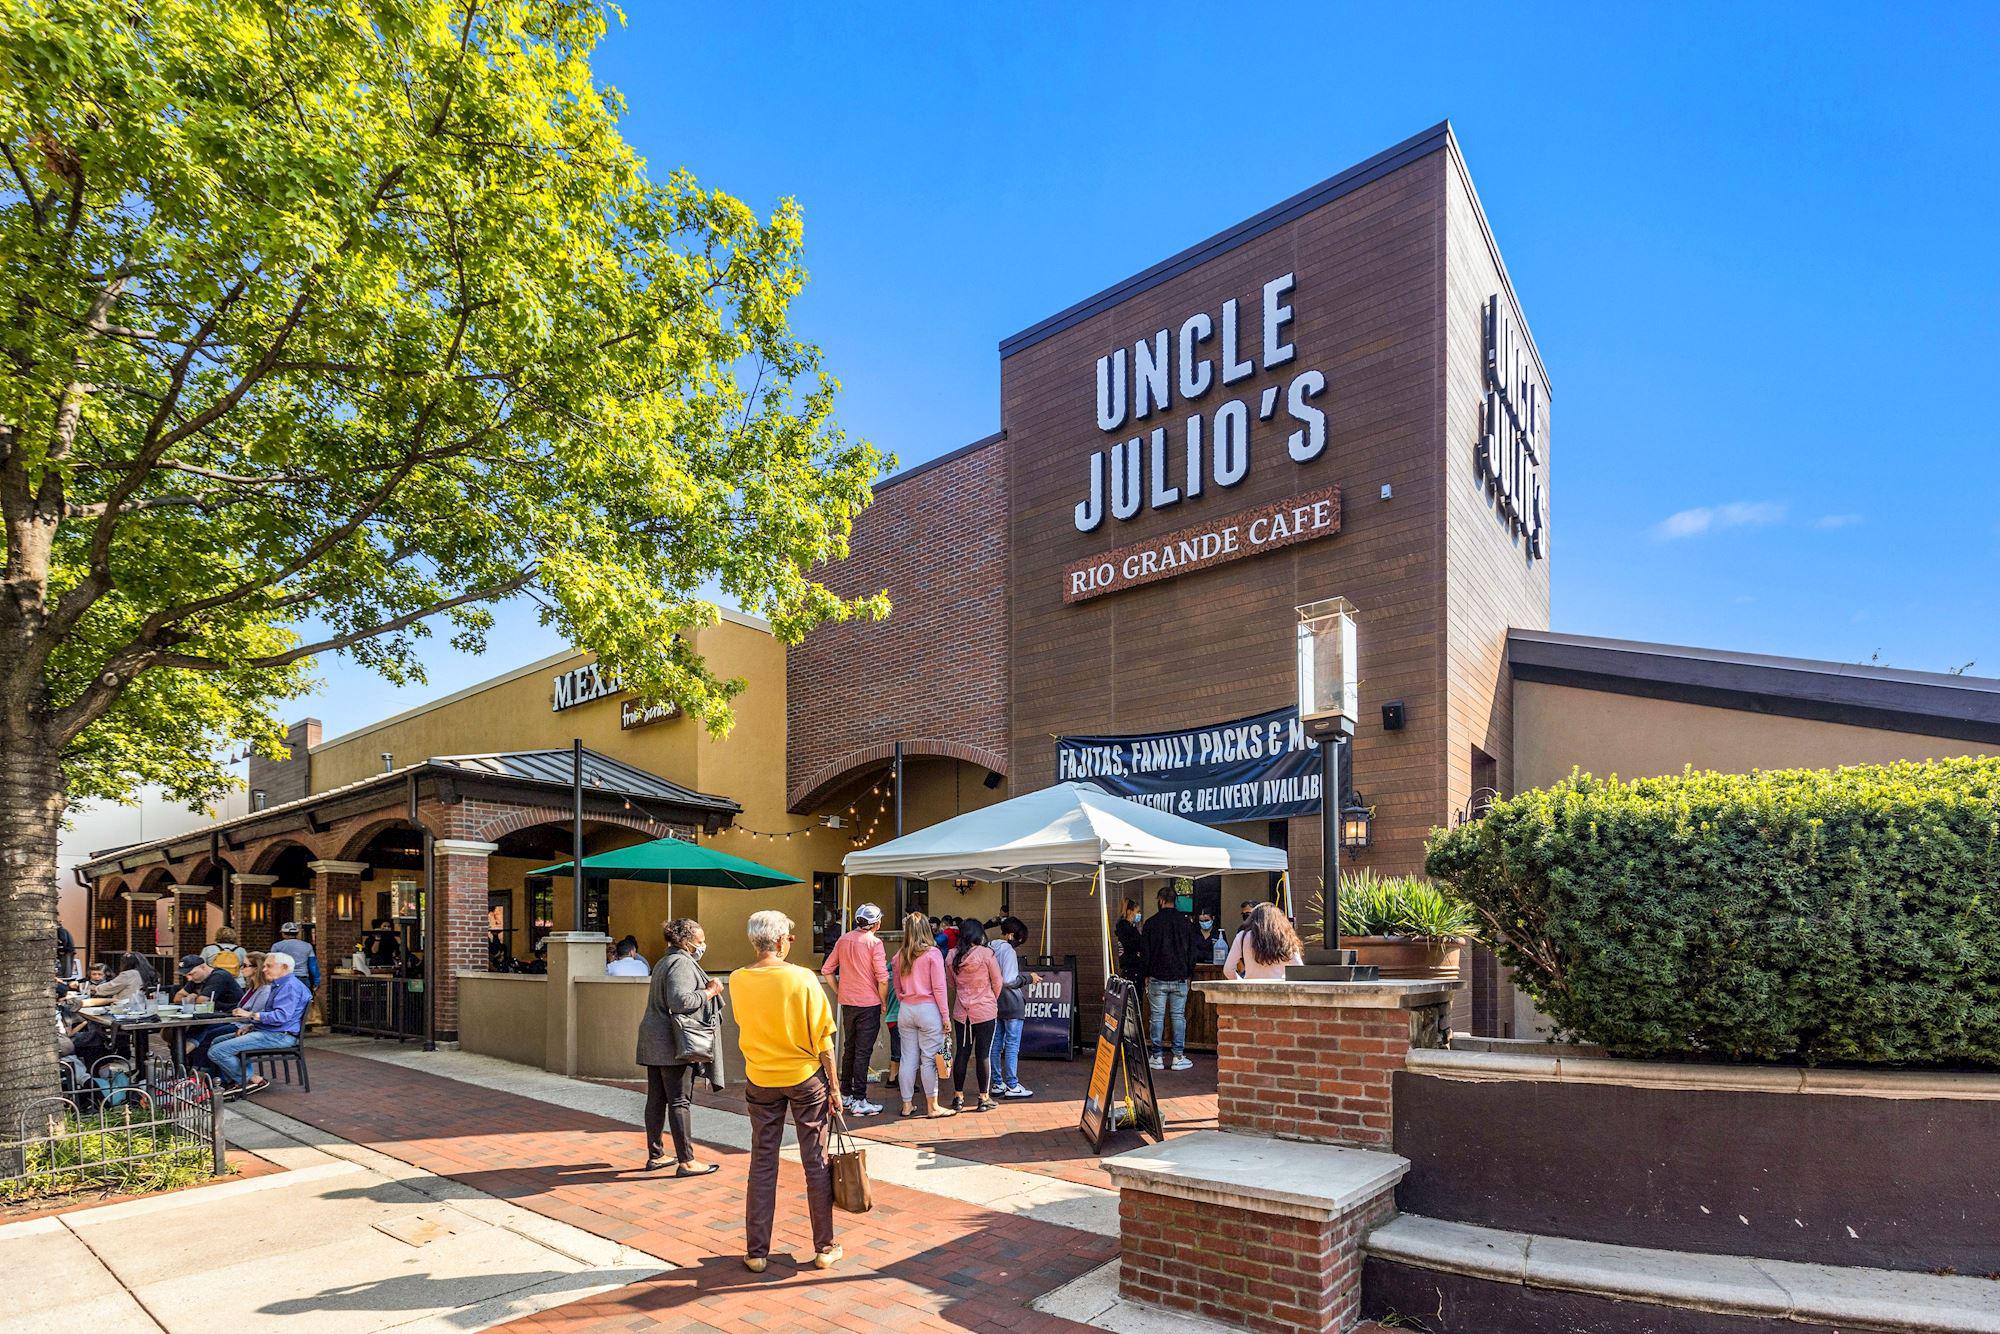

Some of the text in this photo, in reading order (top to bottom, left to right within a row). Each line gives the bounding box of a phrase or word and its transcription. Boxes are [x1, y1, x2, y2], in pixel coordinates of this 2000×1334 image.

[1096, 272, 1297, 433] UNCLE
[1074, 370, 1328, 533] JULIO'S
[1070, 500, 1332, 596] RIO GRANDE CAFE
[1059, 744, 1129, 780] FAJITAS,
[1131, 734, 1195, 774] FAMILY
[1200, 724, 1263, 766] PACKS
[1268, 720, 1283, 757] &
[1178, 789, 1194, 814] &
[1196, 781, 1259, 814] DELIVERY
[1262, 773, 1323, 806] AVAILAB
[1024, 1002, 1070, 1019] HECK-IN
[1028, 982, 1062, 999] PATIO
